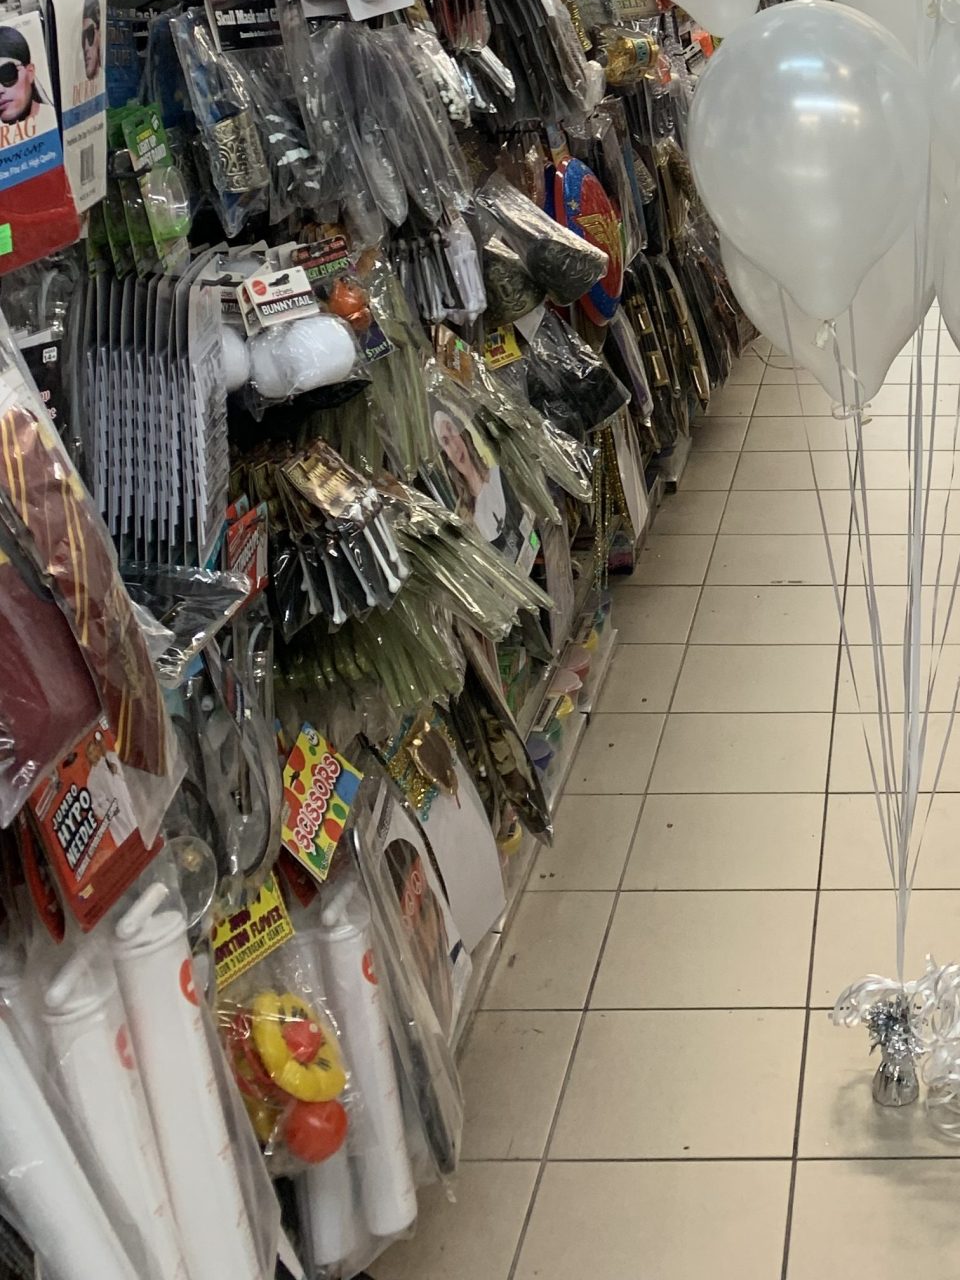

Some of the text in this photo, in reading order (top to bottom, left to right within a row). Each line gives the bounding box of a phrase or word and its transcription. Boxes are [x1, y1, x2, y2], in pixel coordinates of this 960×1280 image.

[215, 10, 236, 26] Skull
[260, 294, 313, 317] BUNNY TAIL
[53, 784, 78, 830] JUMBO
[57, 790, 91, 848] HYPO
[293, 753, 341, 855] SCISSORS
[66, 809, 97, 870] NEEDLE
